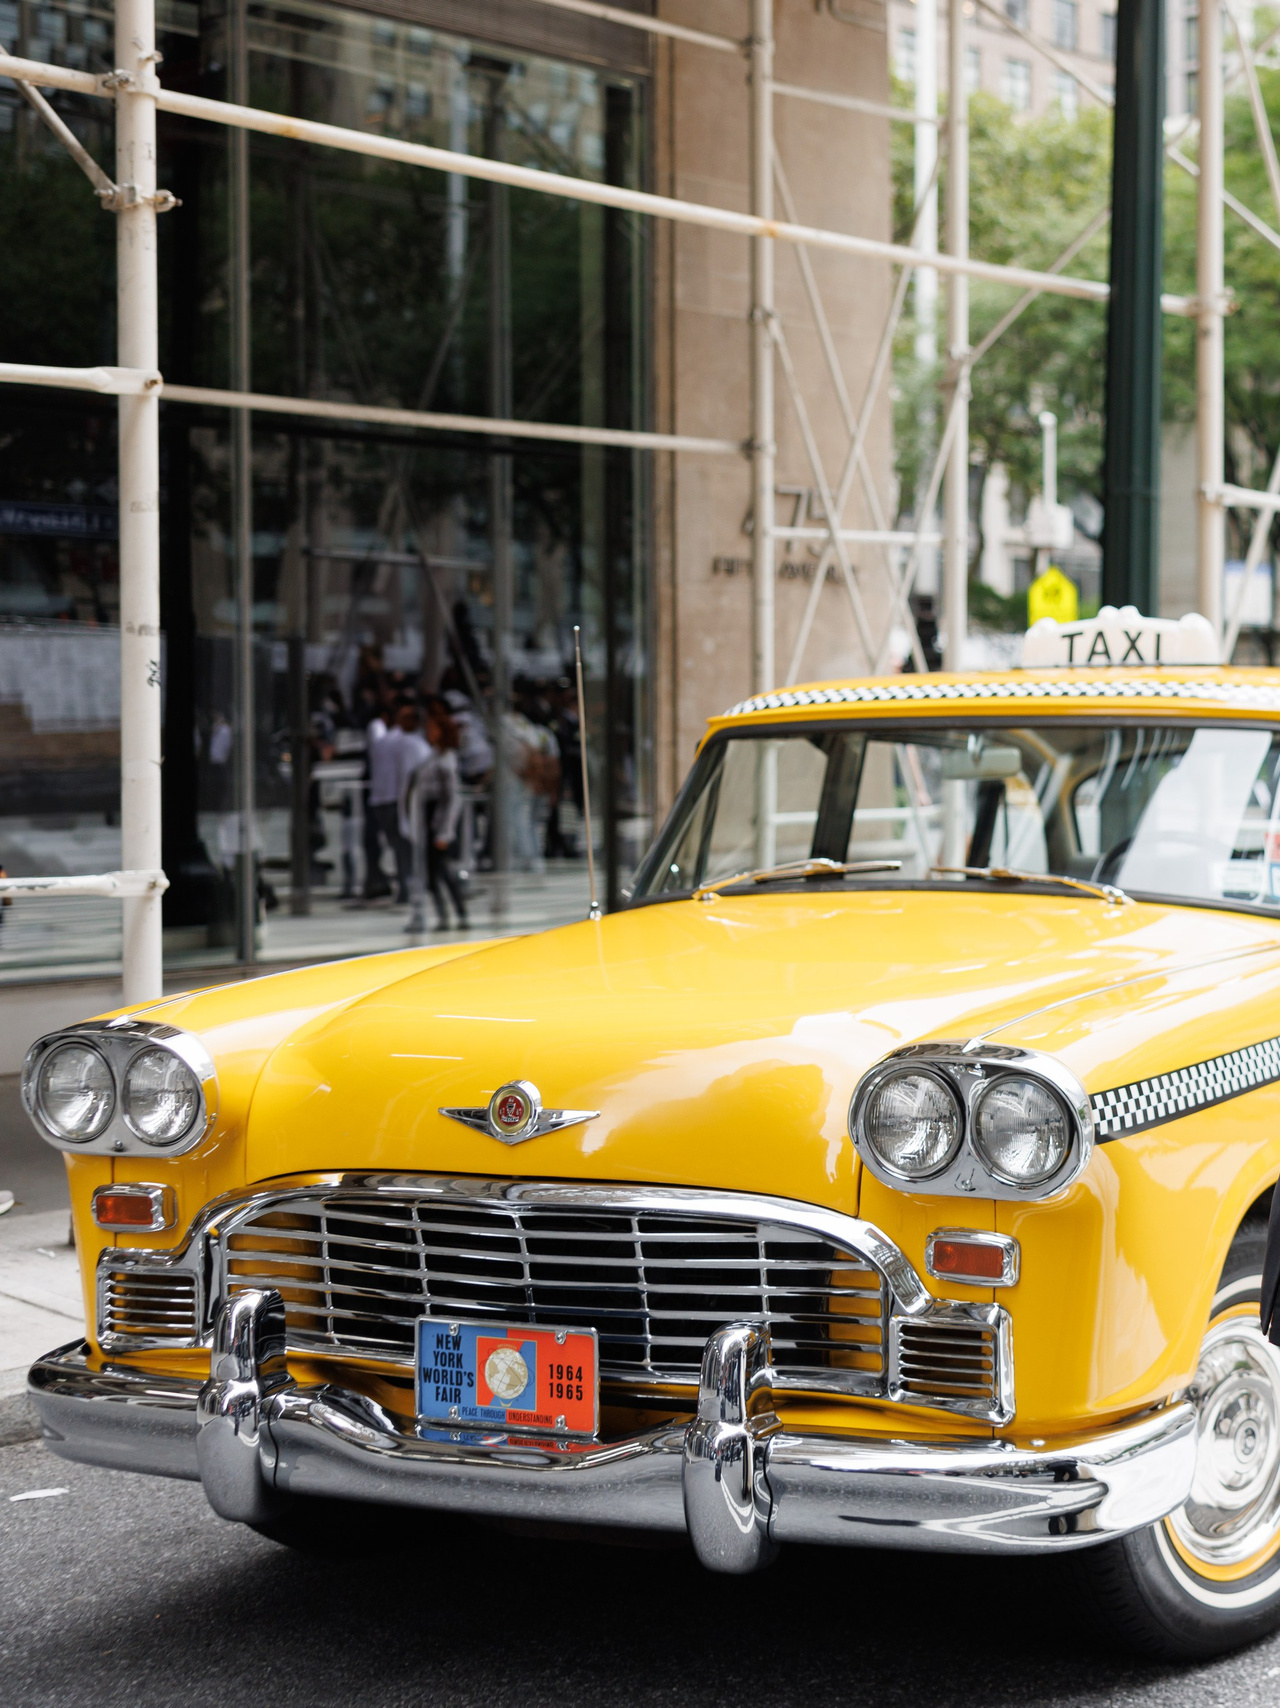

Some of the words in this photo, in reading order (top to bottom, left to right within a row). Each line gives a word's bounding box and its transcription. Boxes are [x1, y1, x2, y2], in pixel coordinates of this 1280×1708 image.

[1061, 630, 1161, 663] TAXI
[436, 1333, 462, 1351] NEW
[433, 1350, 463, 1369] YORK
[423, 1367, 474, 1388] WORLD'S
[549, 1363, 583, 1382] 1964
[435, 1385, 462, 1404] FAIR
[549, 1382, 583, 1401] 1965
[462, 1406, 478, 1417] PEACE
[480, 1409, 506, 1420] THROUGH
[508, 1411, 553, 1425] UNDERSTANDING
